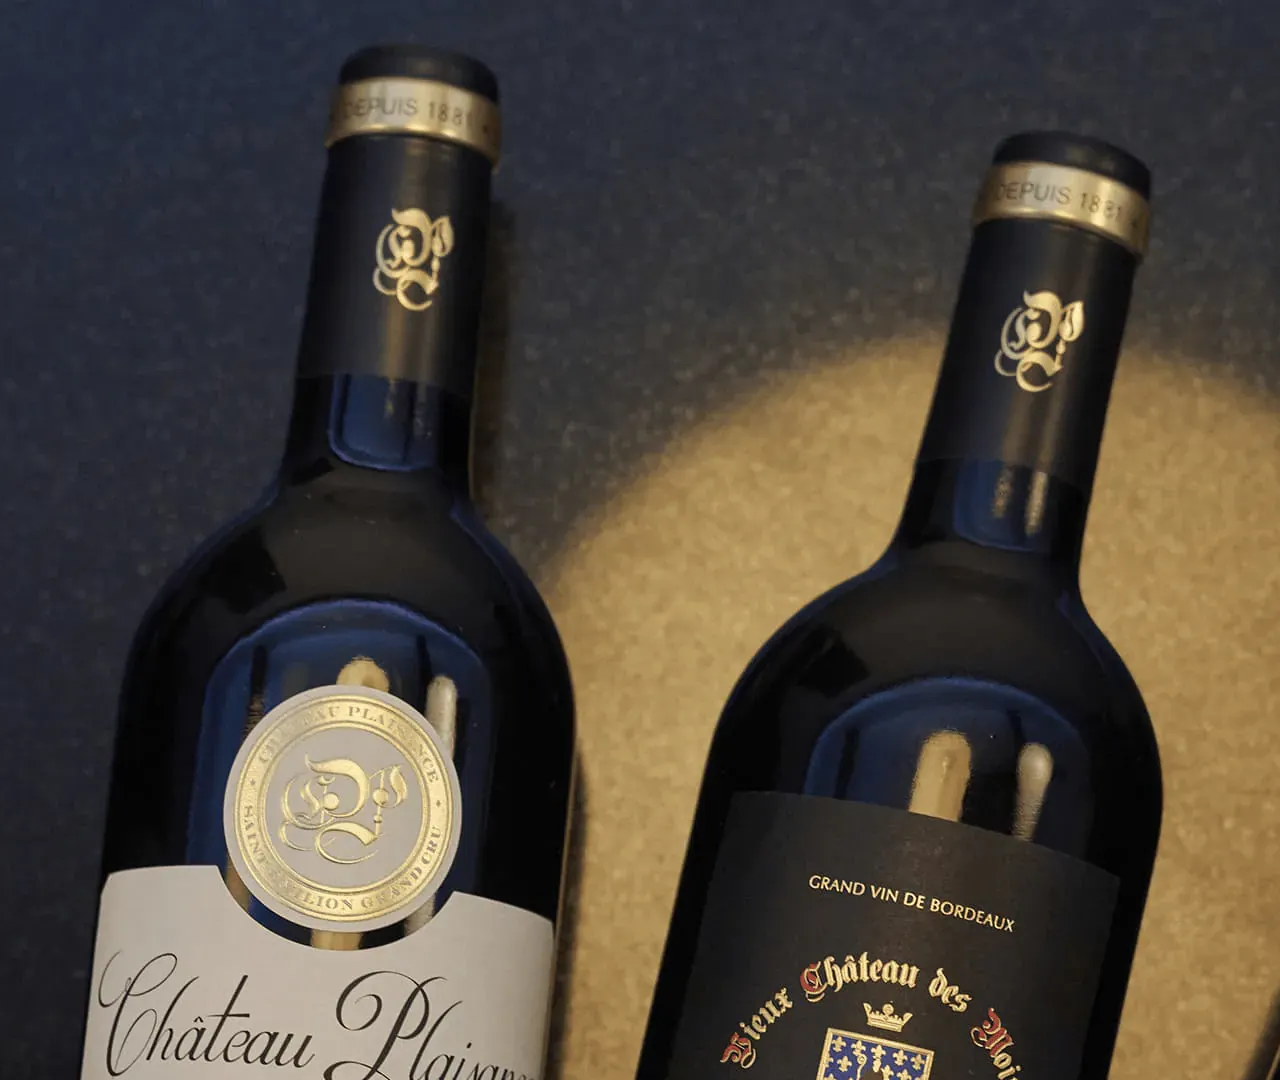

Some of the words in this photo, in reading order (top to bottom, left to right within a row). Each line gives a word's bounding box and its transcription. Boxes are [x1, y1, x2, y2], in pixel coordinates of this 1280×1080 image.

[423, 827, 442, 866] CRU
[808, 874, 866, 896] GRAND
[870, 884, 900, 904] VIN
[903, 891, 926, 910] DE
[930, 898, 1016, 933] BORDEAUX
[97, 950, 315, 1080] Château
[720, 986, 794, 1069] Vieux
[800, 951, 921, 1003] Château
[927, 967, 972, 1013] des
